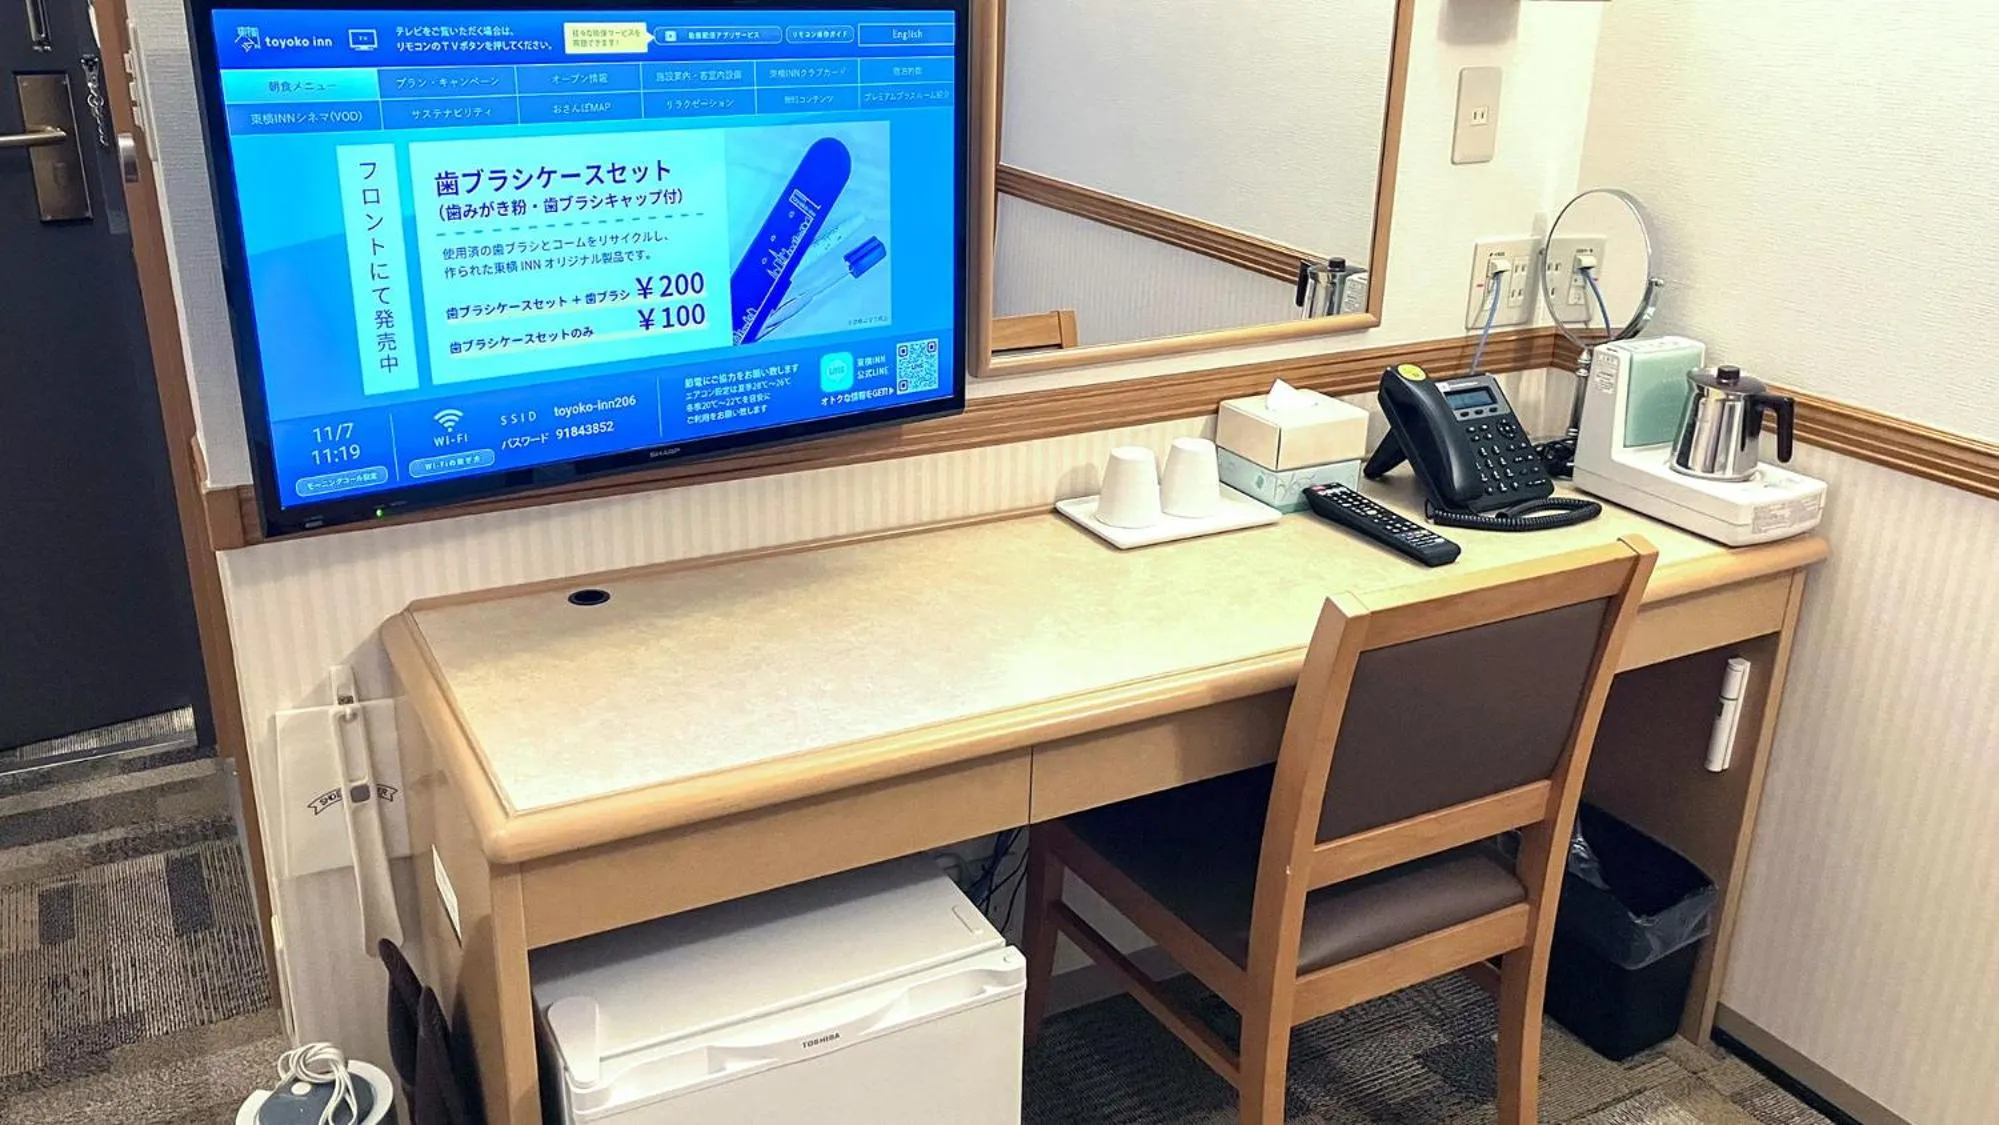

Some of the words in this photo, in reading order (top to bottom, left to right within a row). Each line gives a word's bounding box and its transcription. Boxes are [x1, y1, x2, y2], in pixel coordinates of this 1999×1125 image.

[265, 36, 310, 49] toyoko
[313, 35, 333, 47] inn
[893, 29, 923, 41] English
[268, 80, 337, 93] 朝食メニュー
[396, 76, 500, 89] プラン・キャンペーン
[551, 72, 609, 85] オープン情報
[411, 107, 493, 120] サステナビリティ
[434, 159, 671, 198] 歯ブラシケースセット
[438, 187, 683, 222] (歯みがき粉・歯ブラシキャップ付)
[442, 231, 669, 261] 使用済の歯ブラシとコームをリサイクルし、
[359, 161, 399, 374] フロントにて発売中
[635, 271, 705, 300] ¥200
[449, 326, 594, 355] 歯ブラシケースセットのみ
[637, 303, 706, 331] ¥100
[500, 410, 537, 426] SSID
[553, 395, 637, 419] toyoko-inn206
[312, 422, 354, 443] 11/7
[501, 432, 550, 449] パスワード
[555, 421, 615, 440] 91843852
[311, 443, 361, 465] 11:19
[802, 1032, 840, 1048] TOSHIBA
